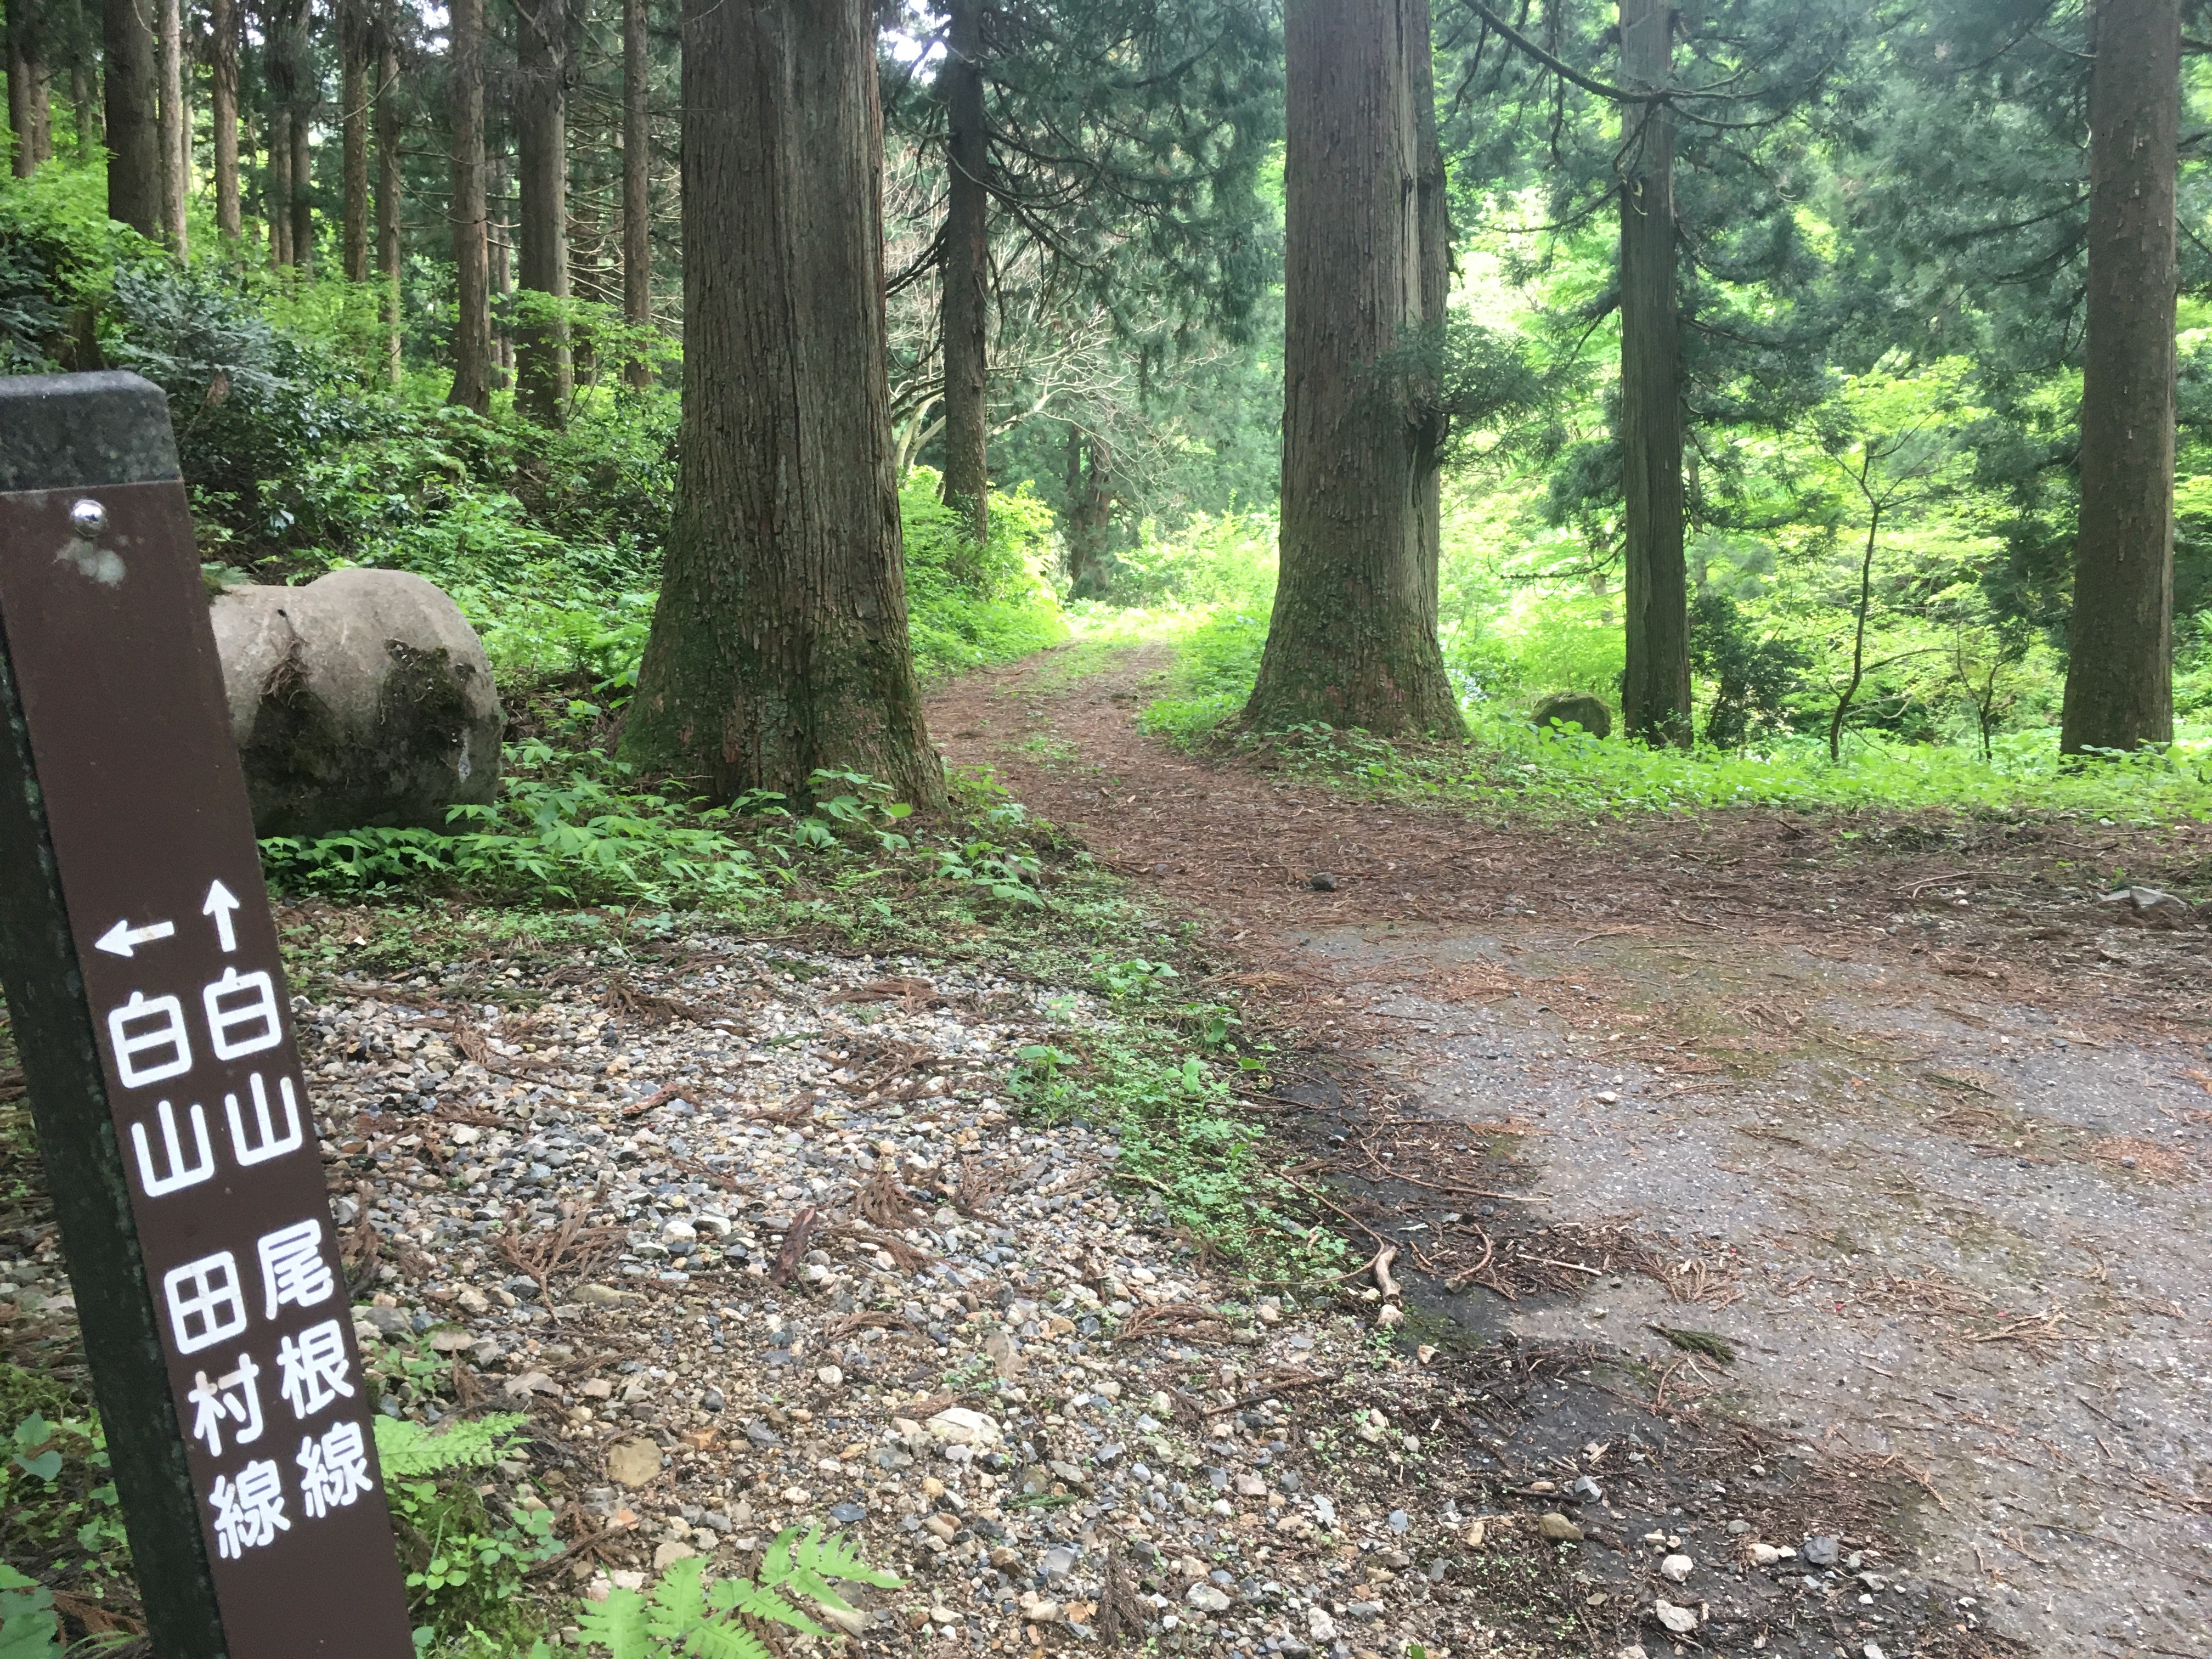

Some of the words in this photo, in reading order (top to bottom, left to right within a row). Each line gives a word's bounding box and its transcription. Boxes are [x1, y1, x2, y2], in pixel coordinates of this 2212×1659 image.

[108, 991, 216, 1198] 白山
[163, 1250, 291, 1560] 田村線
[202, 966, 303, 1167] 白山
[257, 1218, 374, 1519] 尾根線
